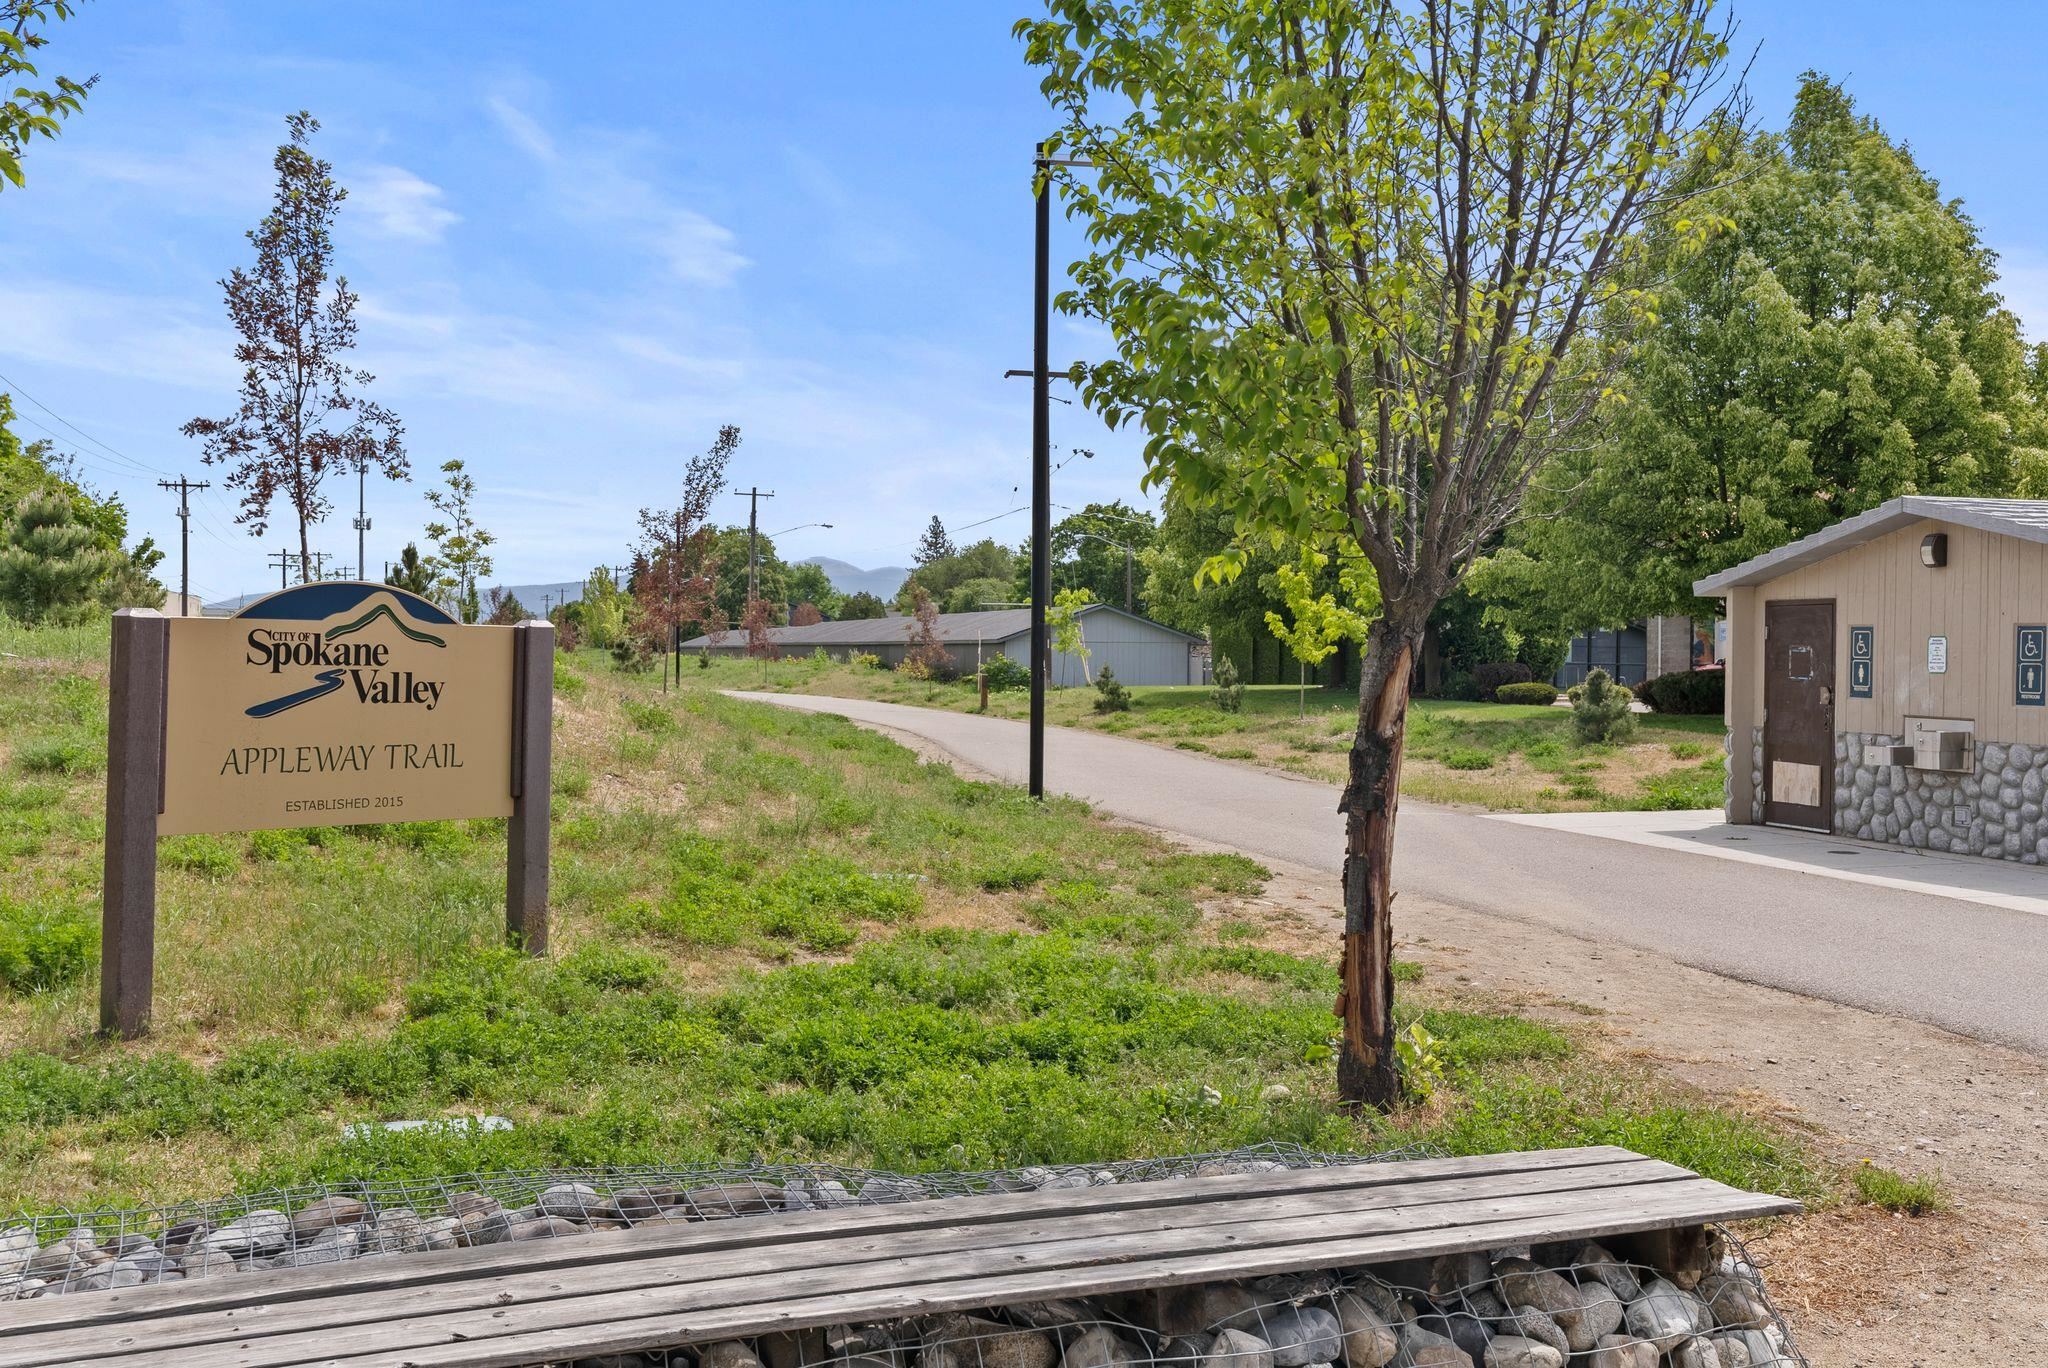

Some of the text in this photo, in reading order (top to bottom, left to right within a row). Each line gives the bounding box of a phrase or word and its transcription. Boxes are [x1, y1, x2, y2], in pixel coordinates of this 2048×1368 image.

[246, 628, 389, 673] Spokane
[272, 631, 311, 641] CITY OF
[348, 669, 446, 711] Valley
[220, 743, 464, 776] APPLEWAY TRAIL
[285, 796, 404, 812] ESTABLISHED 2015
